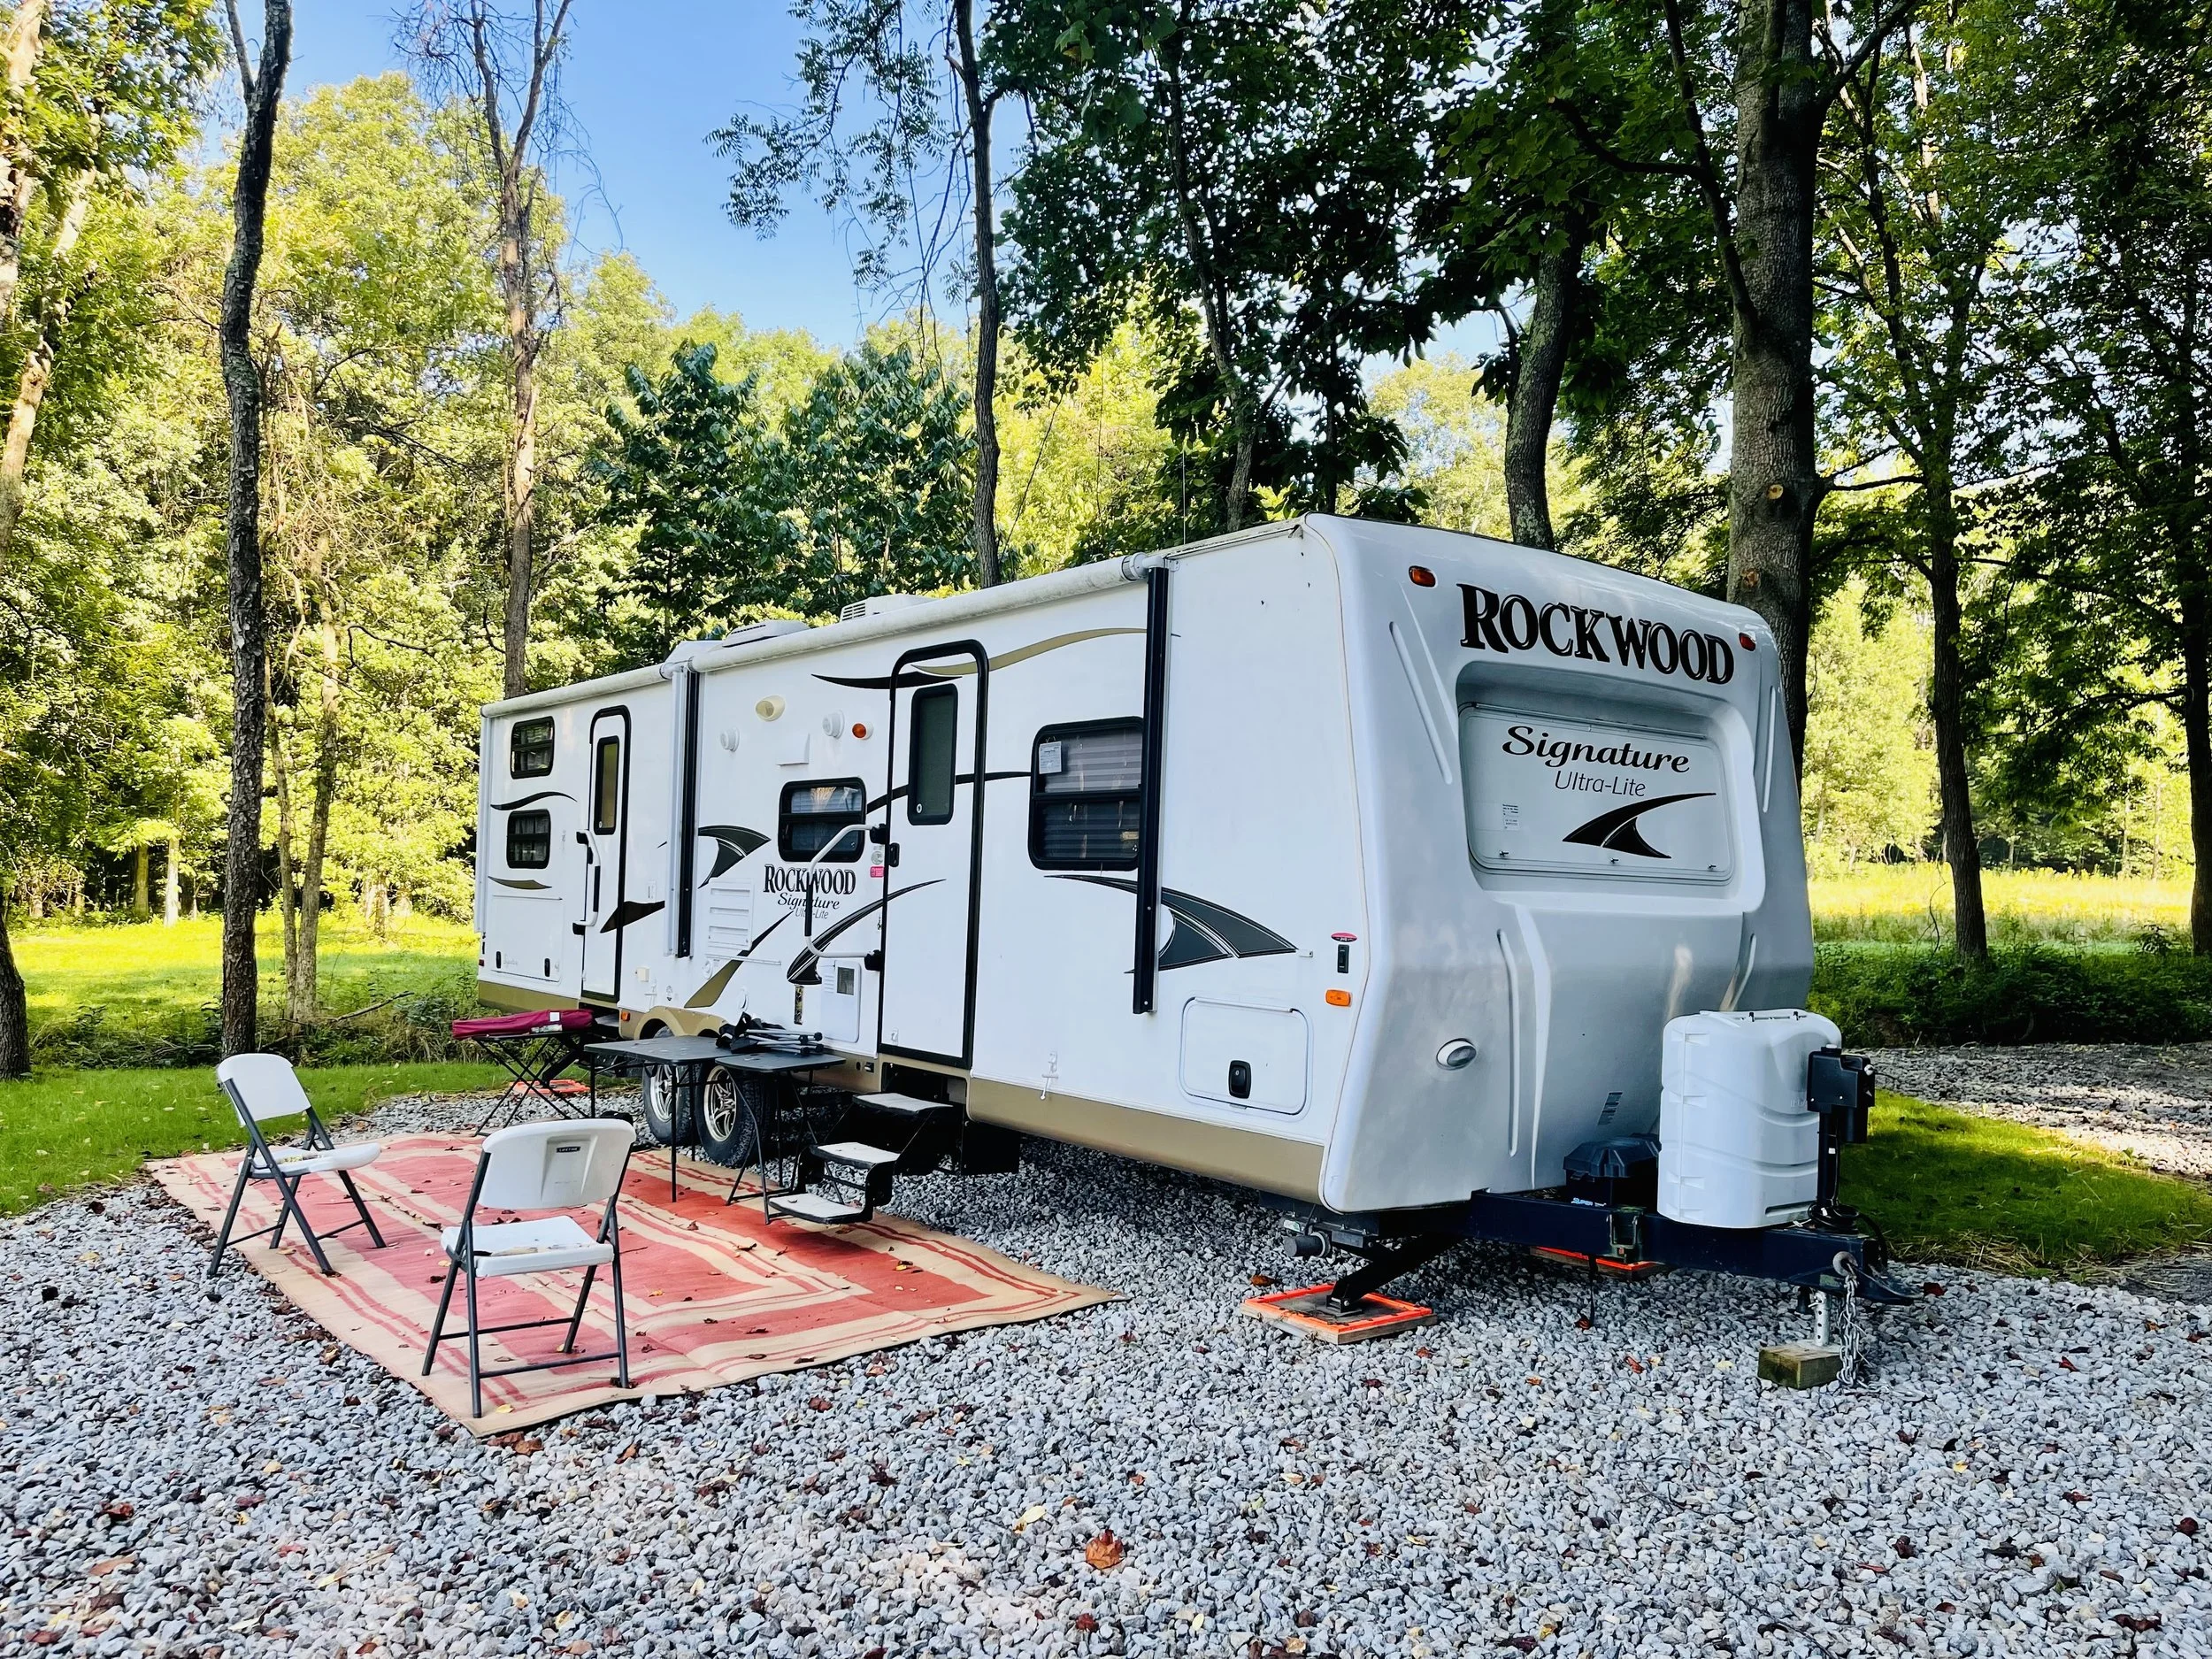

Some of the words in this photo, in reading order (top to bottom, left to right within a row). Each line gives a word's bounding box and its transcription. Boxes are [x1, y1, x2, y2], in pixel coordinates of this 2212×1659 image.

[1456, 584, 1735, 685] ROCKWOOD
[1502, 726, 1690, 773] Signature
[1555, 770, 1646, 796] Ultra-Lite
[778, 892, 840, 910] Signture
